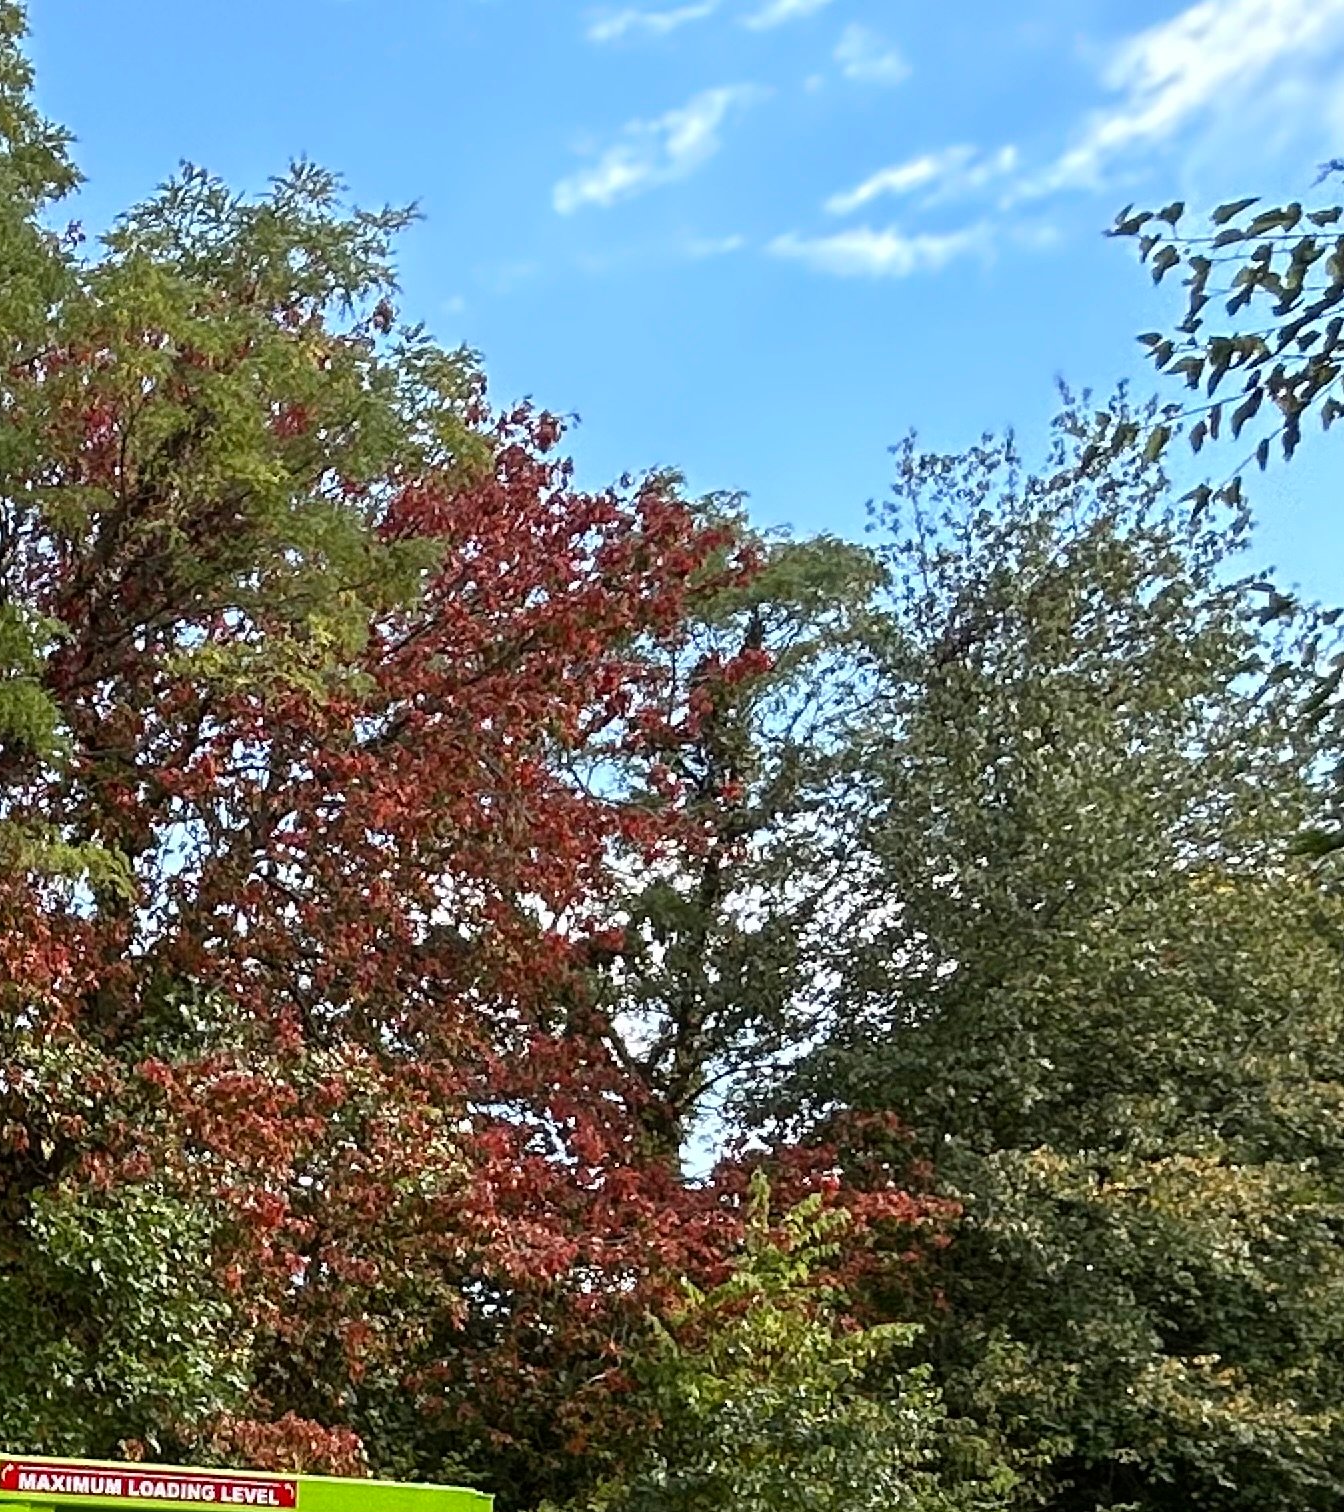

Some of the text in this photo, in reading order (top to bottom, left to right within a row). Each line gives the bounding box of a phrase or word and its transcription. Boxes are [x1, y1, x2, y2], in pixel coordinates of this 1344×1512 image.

[18, 1472, 279, 1506] MAXIMUM LOADING LEVEL
